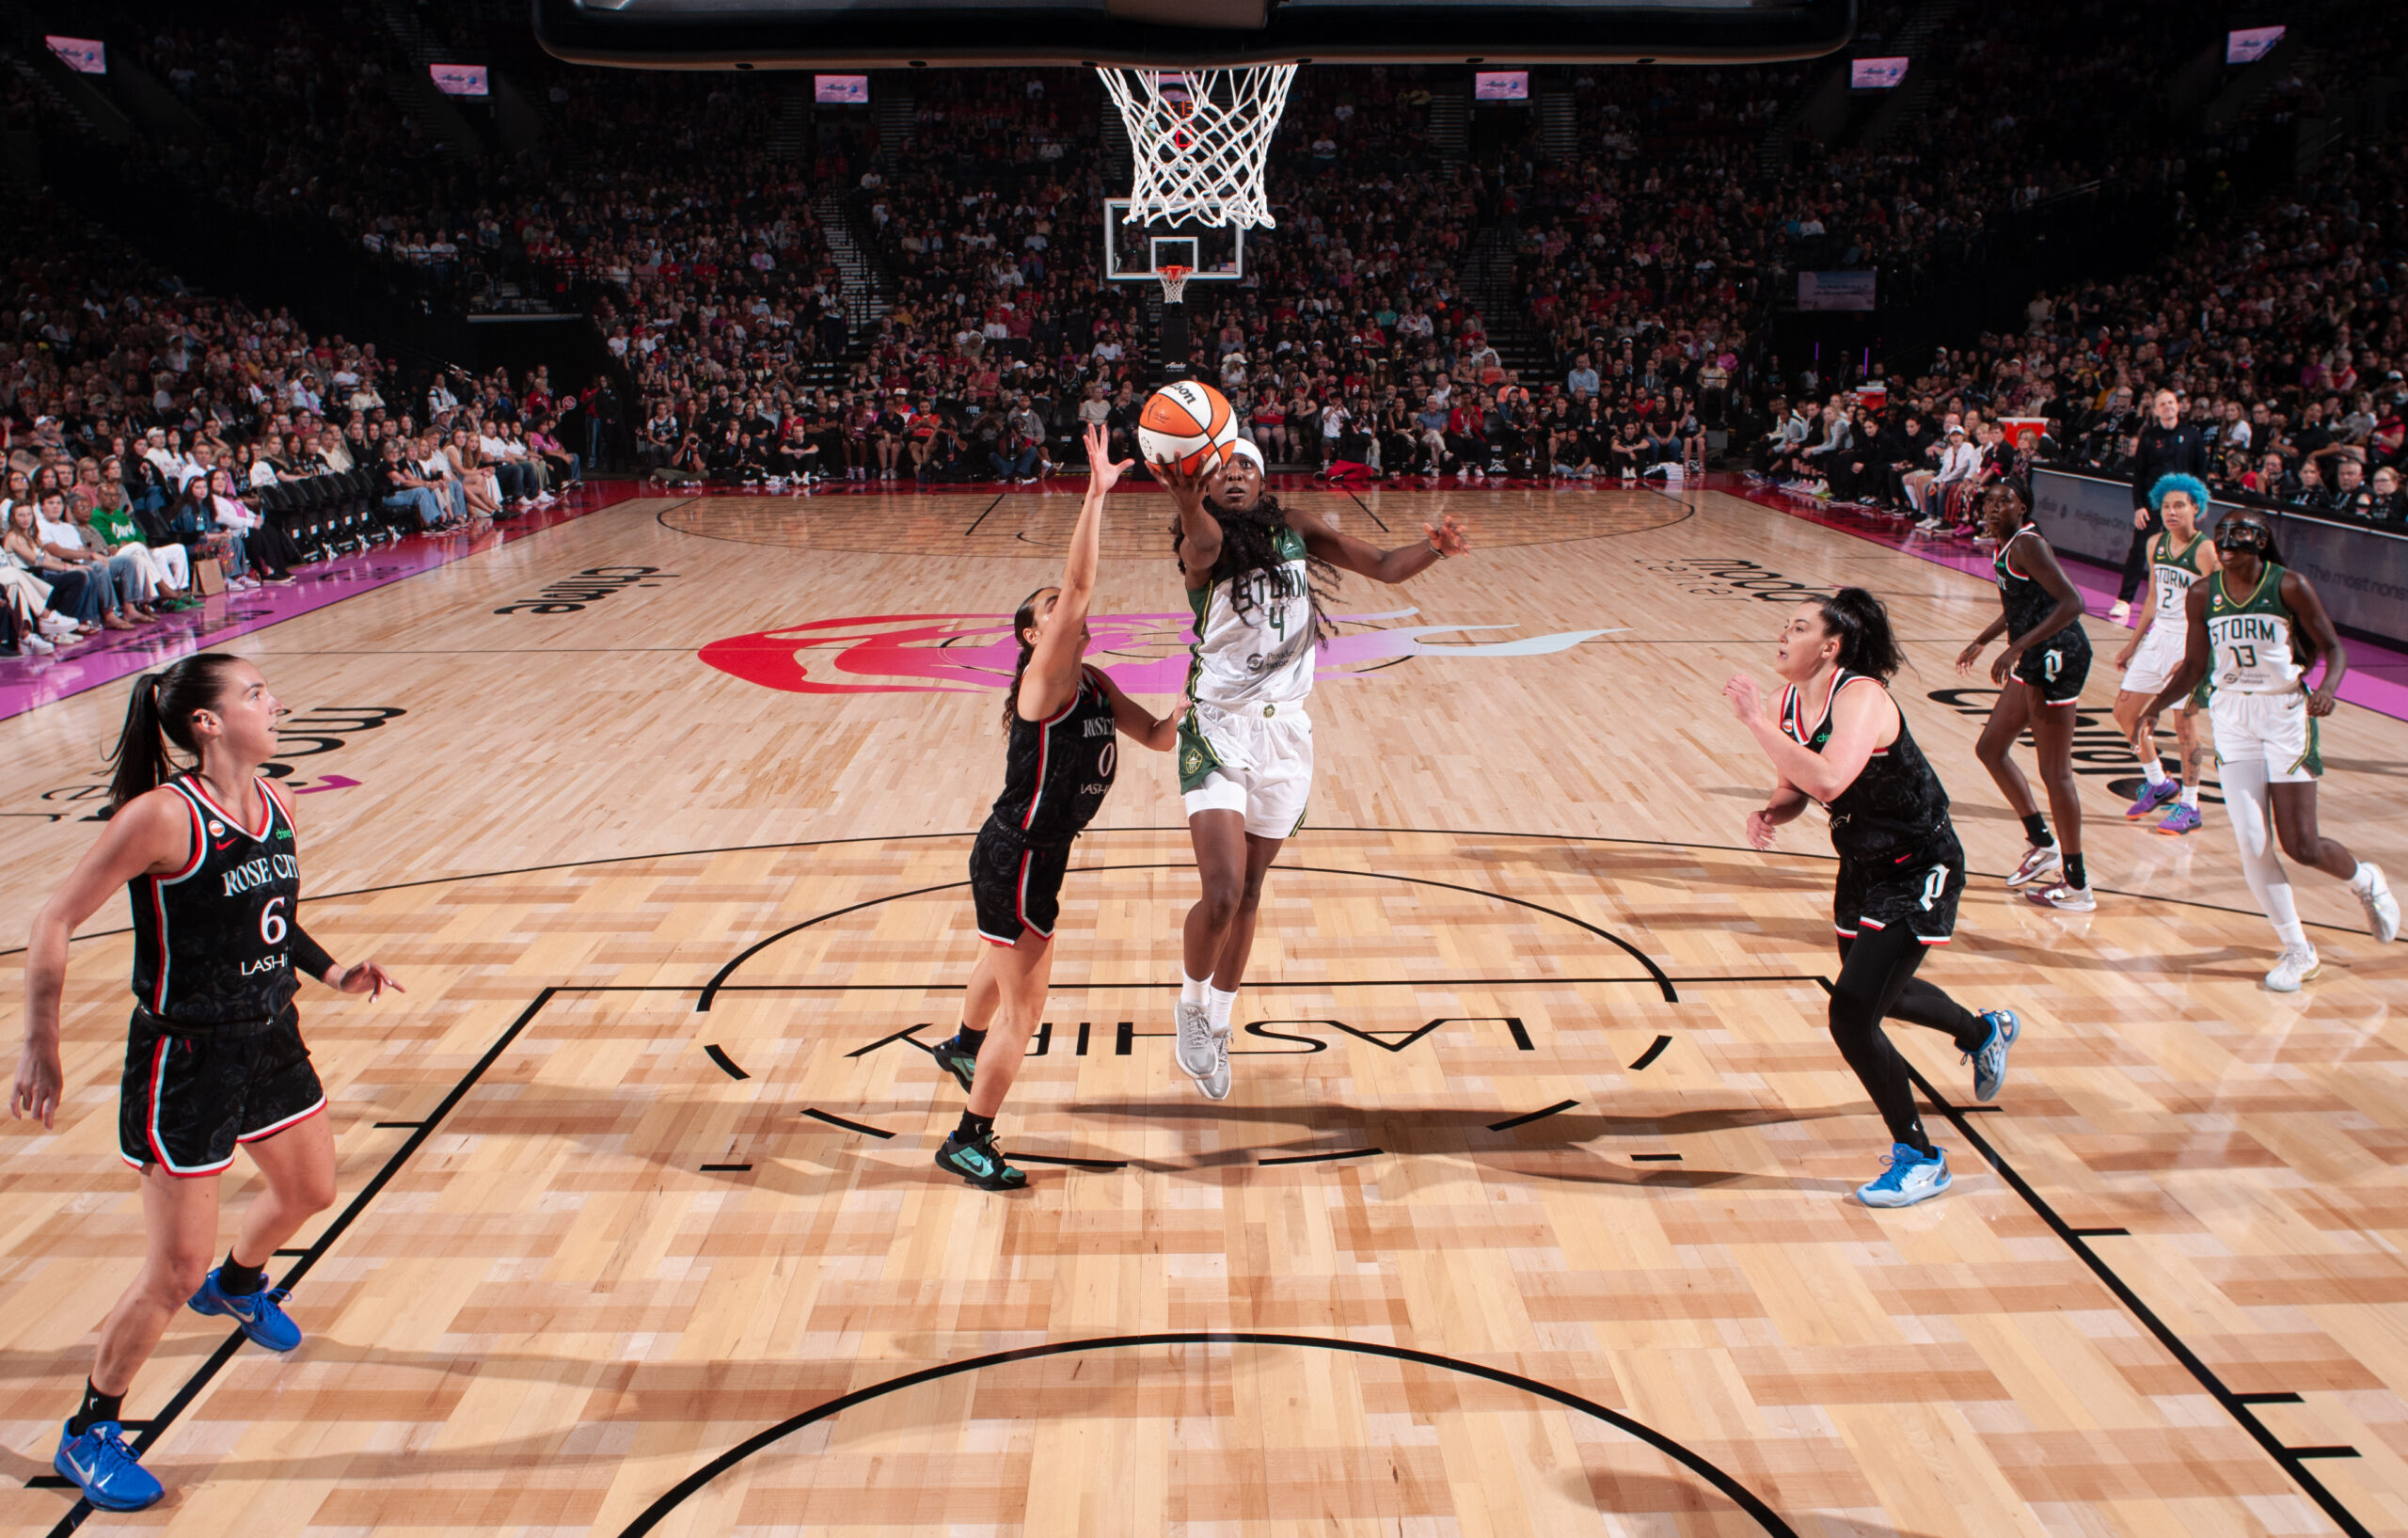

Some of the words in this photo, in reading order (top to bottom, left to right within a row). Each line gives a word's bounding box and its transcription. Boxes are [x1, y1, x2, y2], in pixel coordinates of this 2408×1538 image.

[2156, 567, 2191, 588] TORM
[2162, 588, 2174, 609] 2
[2371, 581, 2408, 601] nons
[1269, 607, 1285, 642] 4
[2211, 618, 2275, 645] STORM
[2229, 644, 2258, 668] 13
[221, 857, 272, 896] ROSE
[273, 853, 299, 879] CIT
[261, 896, 288, 945] 6
